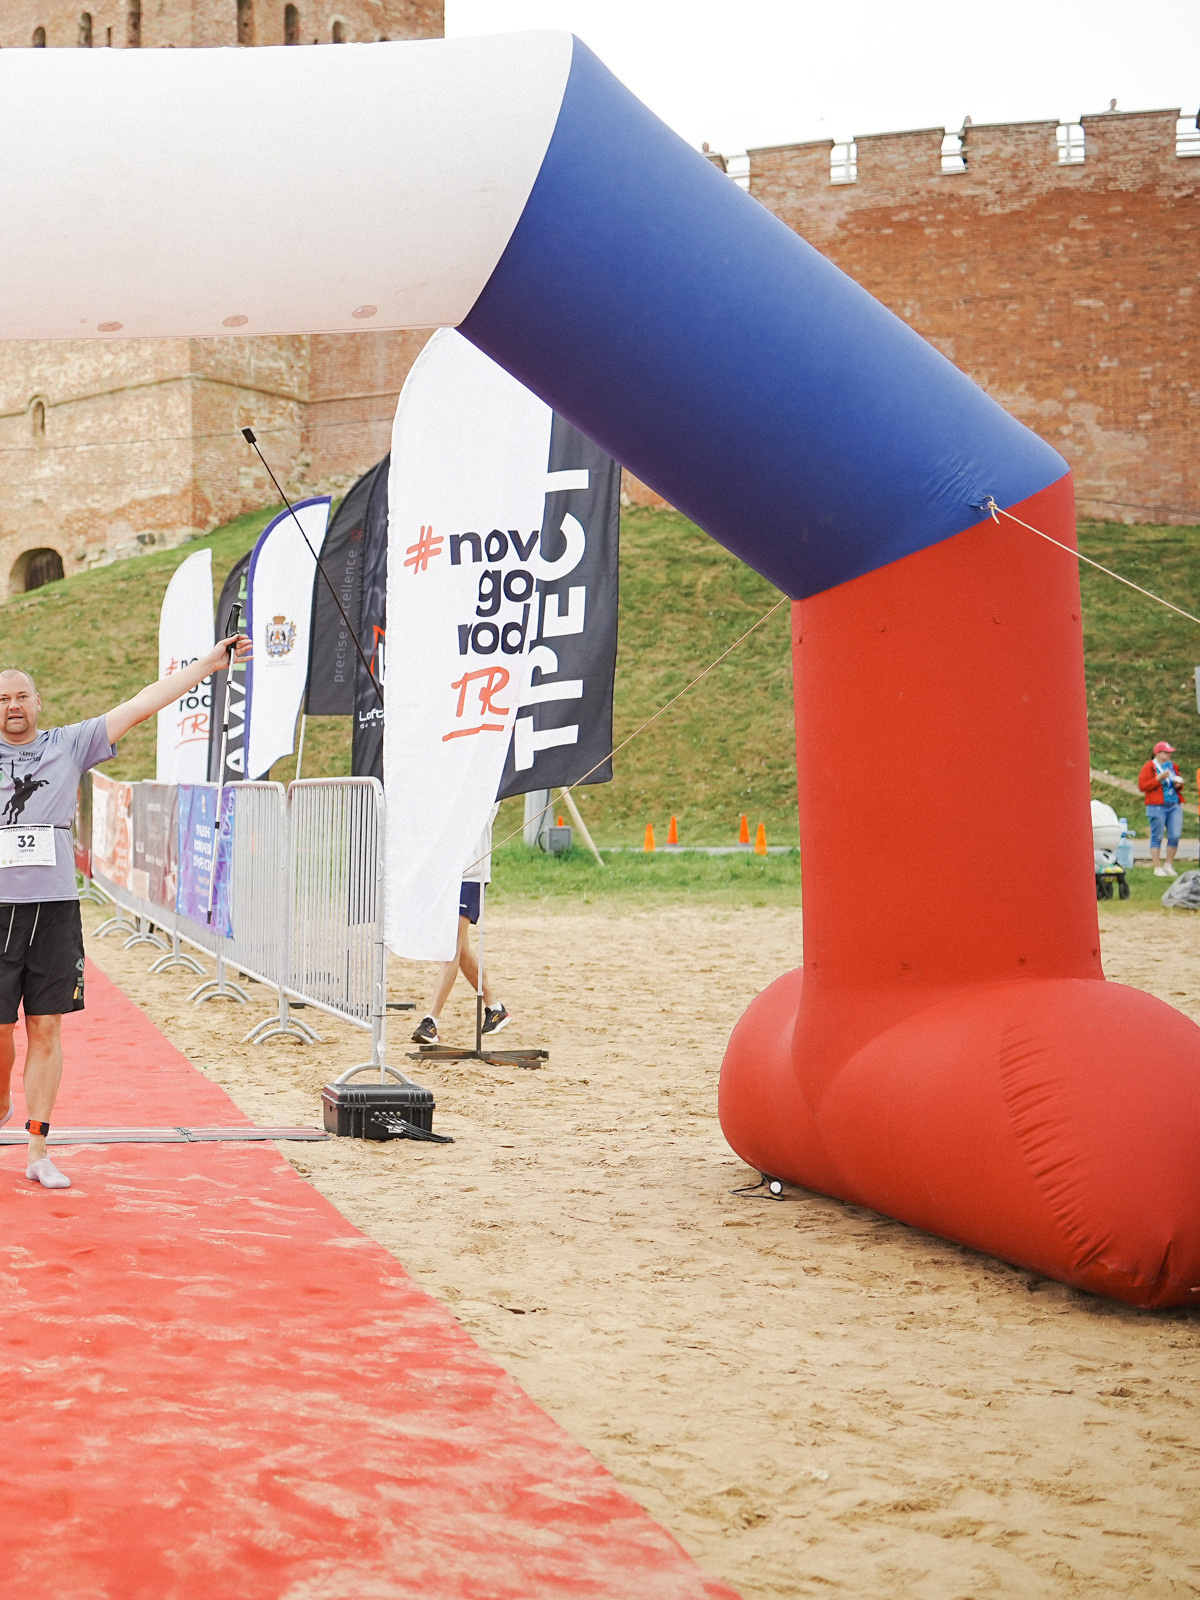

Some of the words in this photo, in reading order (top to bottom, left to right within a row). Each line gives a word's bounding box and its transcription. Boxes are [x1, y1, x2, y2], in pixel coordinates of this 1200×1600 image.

[403, 525, 540, 575] #nov
[476, 569, 534, 617] go
[458, 603, 531, 655] rod
[334, 632, 348, 683] precise
[17, 835, 36, 848] 32
